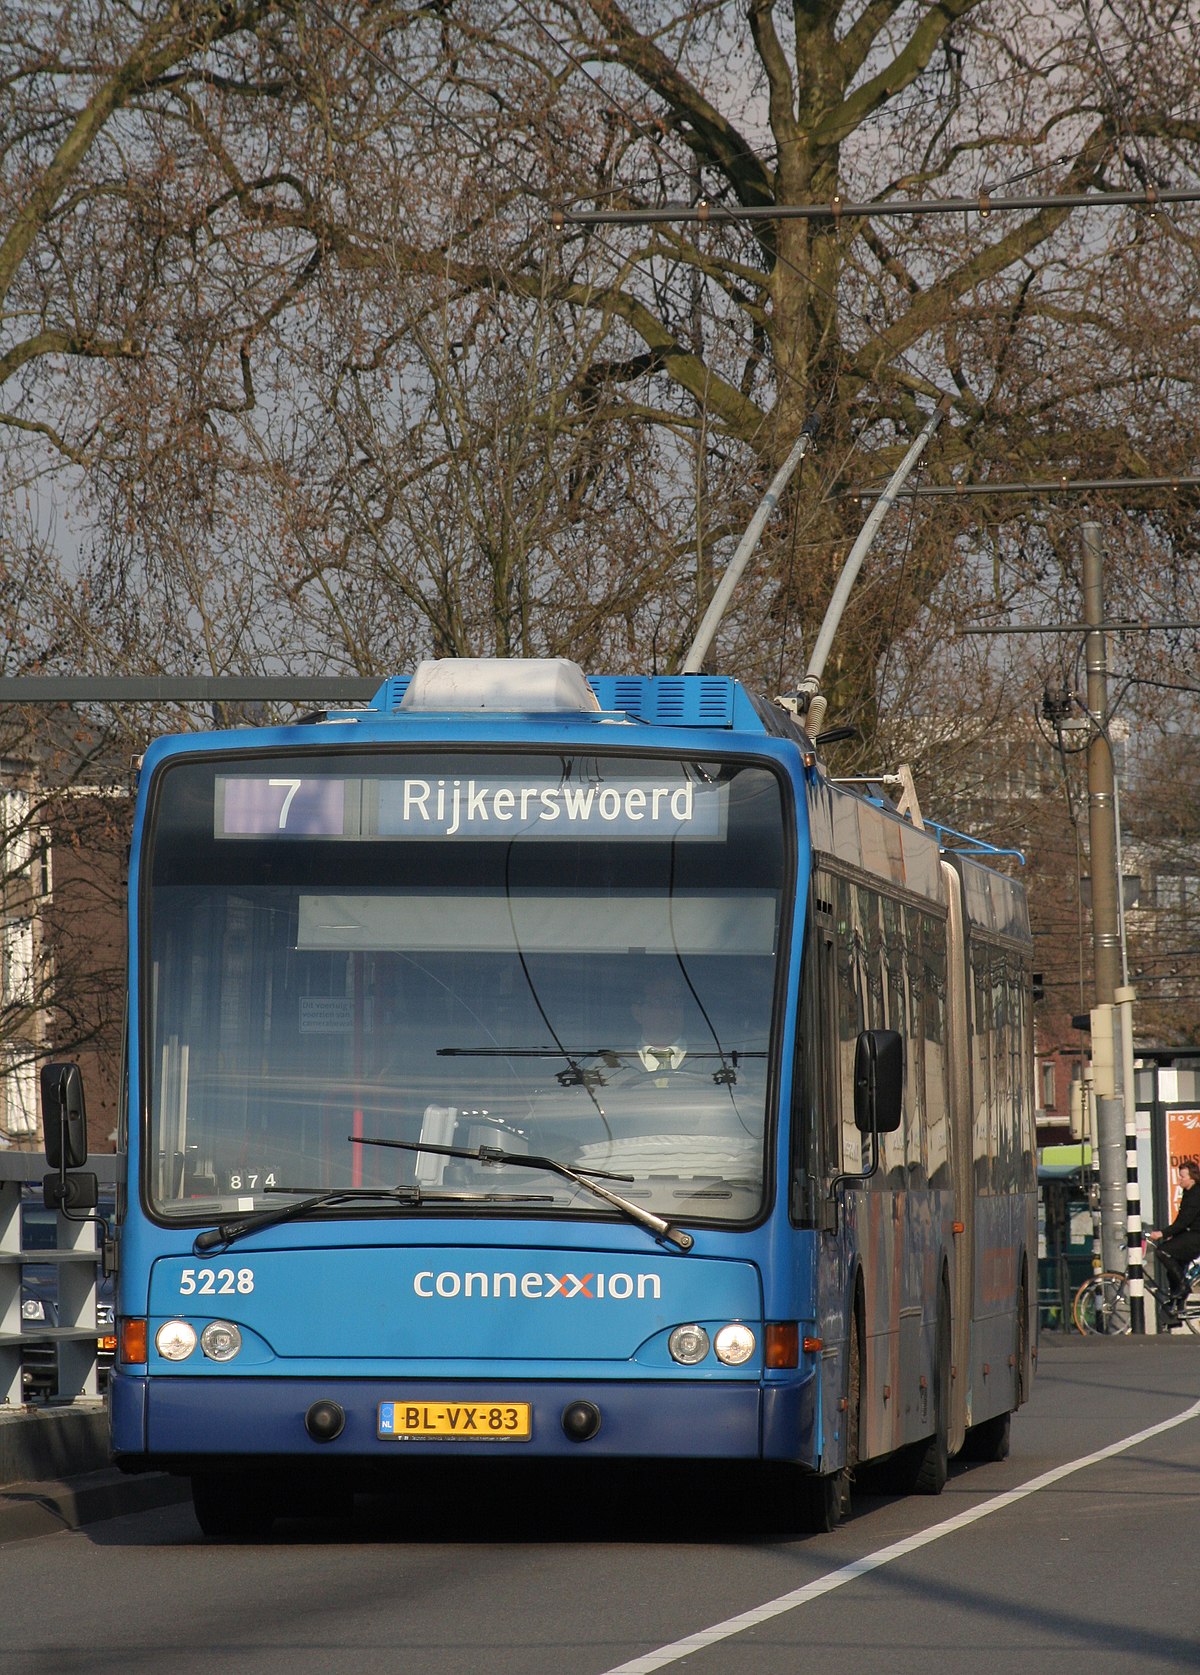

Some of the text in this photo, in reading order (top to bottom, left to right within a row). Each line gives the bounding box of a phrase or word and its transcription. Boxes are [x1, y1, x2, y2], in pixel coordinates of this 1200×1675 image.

[268, 778, 693, 835] 7 Rijkerswoerd
[179, 1268, 255, 1296] 5228
[412, 1271, 662, 1299] connexxion
[381, 1420, 393, 1429] NL
[405, 1407, 519, 1430] BL-VX-83
